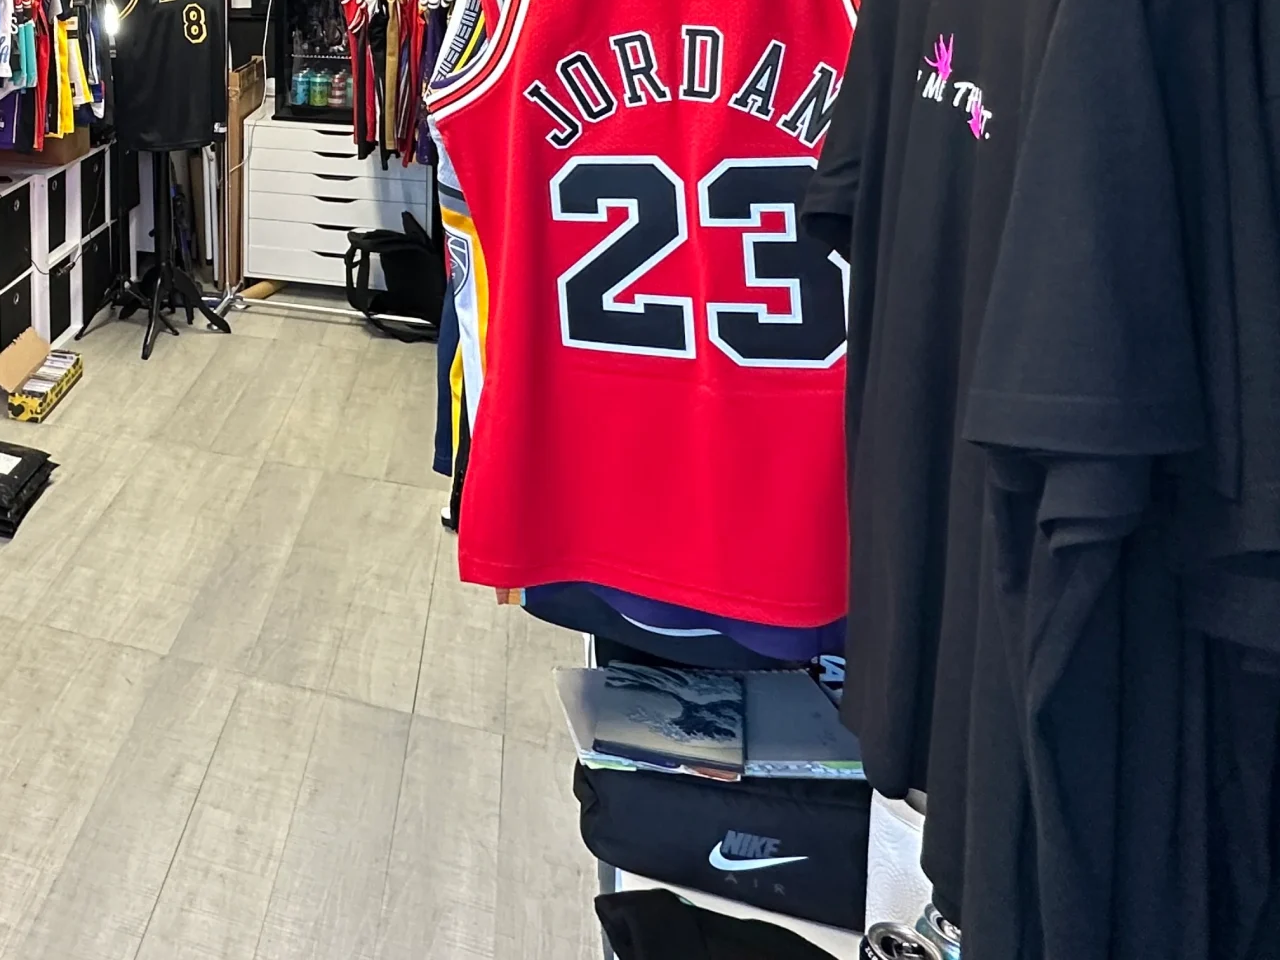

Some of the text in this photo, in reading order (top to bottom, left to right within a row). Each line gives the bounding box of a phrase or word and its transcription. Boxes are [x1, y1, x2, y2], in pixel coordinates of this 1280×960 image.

[183, 3, 207, 44] 8
[524, 25, 844, 151] JORDAN
[550, 155, 850, 369] 23
[721, 829, 781, 860] NIKE
[724, 871, 786, 896] AIR
